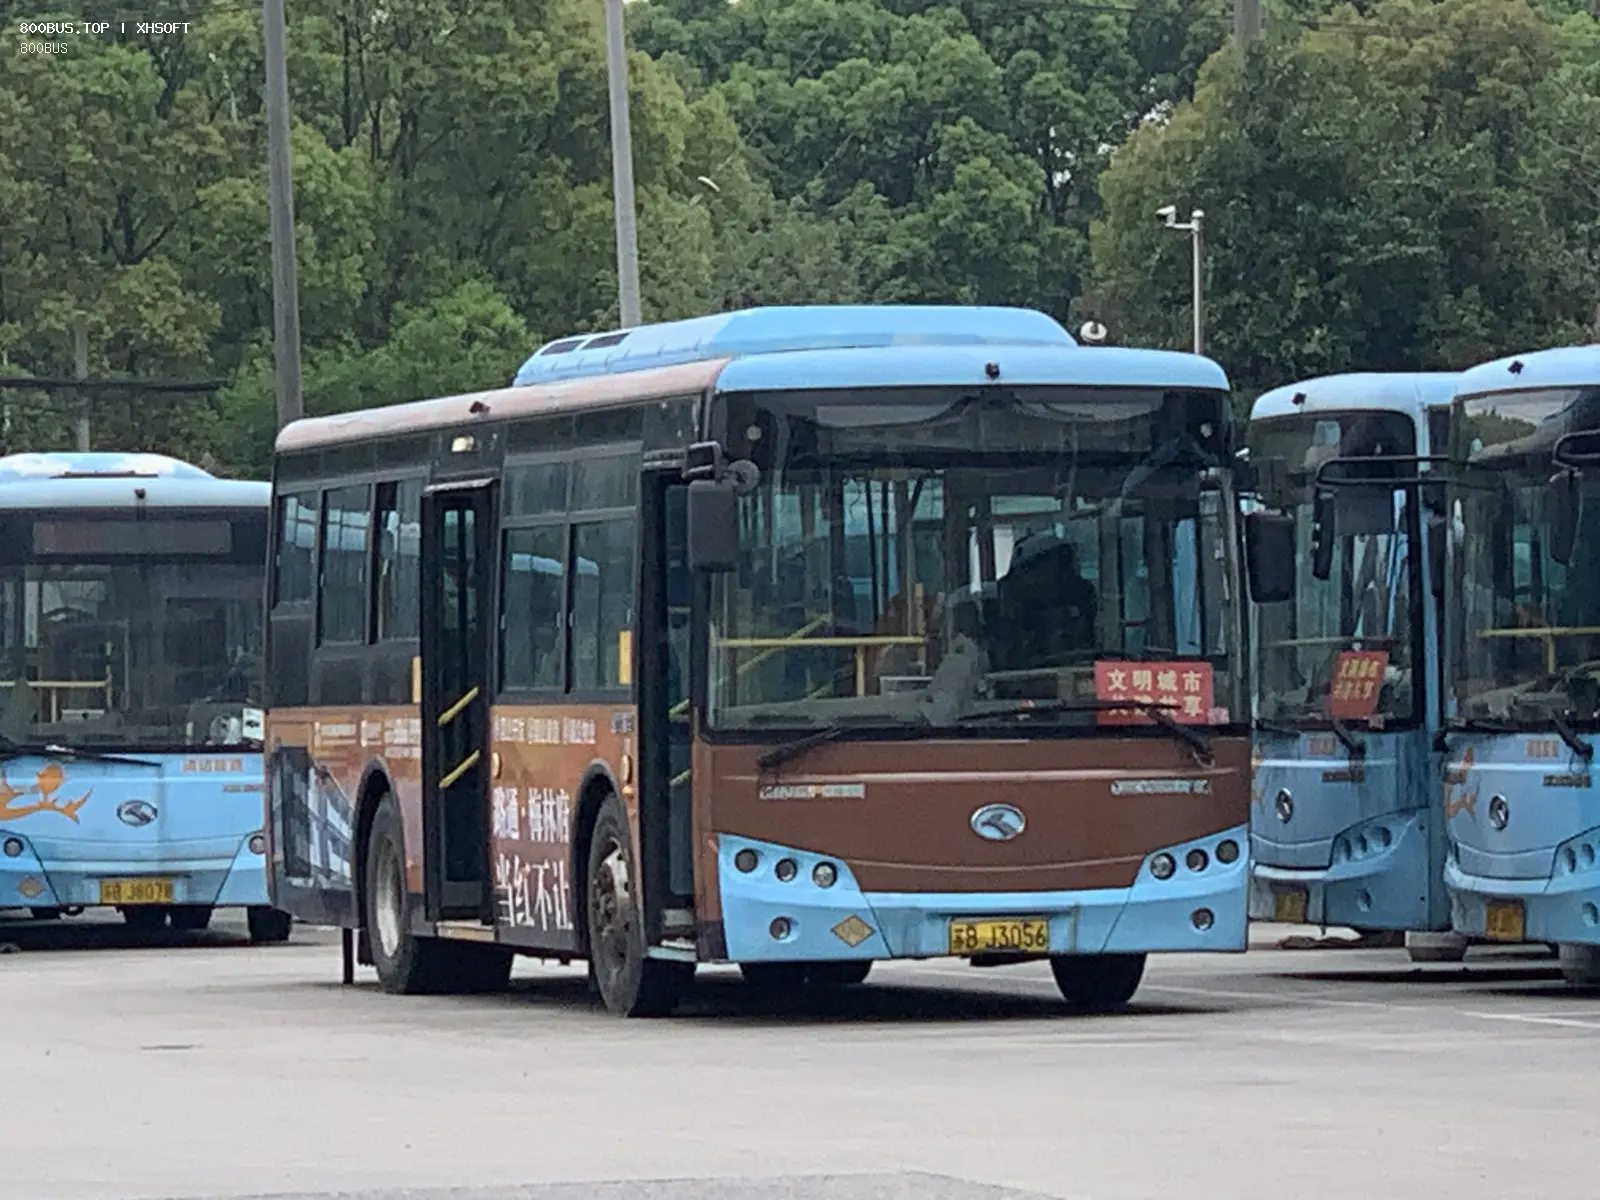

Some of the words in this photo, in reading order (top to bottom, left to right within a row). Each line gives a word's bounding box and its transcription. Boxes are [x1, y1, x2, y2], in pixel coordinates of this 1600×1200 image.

[1107, 668, 1203, 692] 文明城市
[495, 852, 575, 932] 当红不让
[985, 921, 1048, 949] J3056
